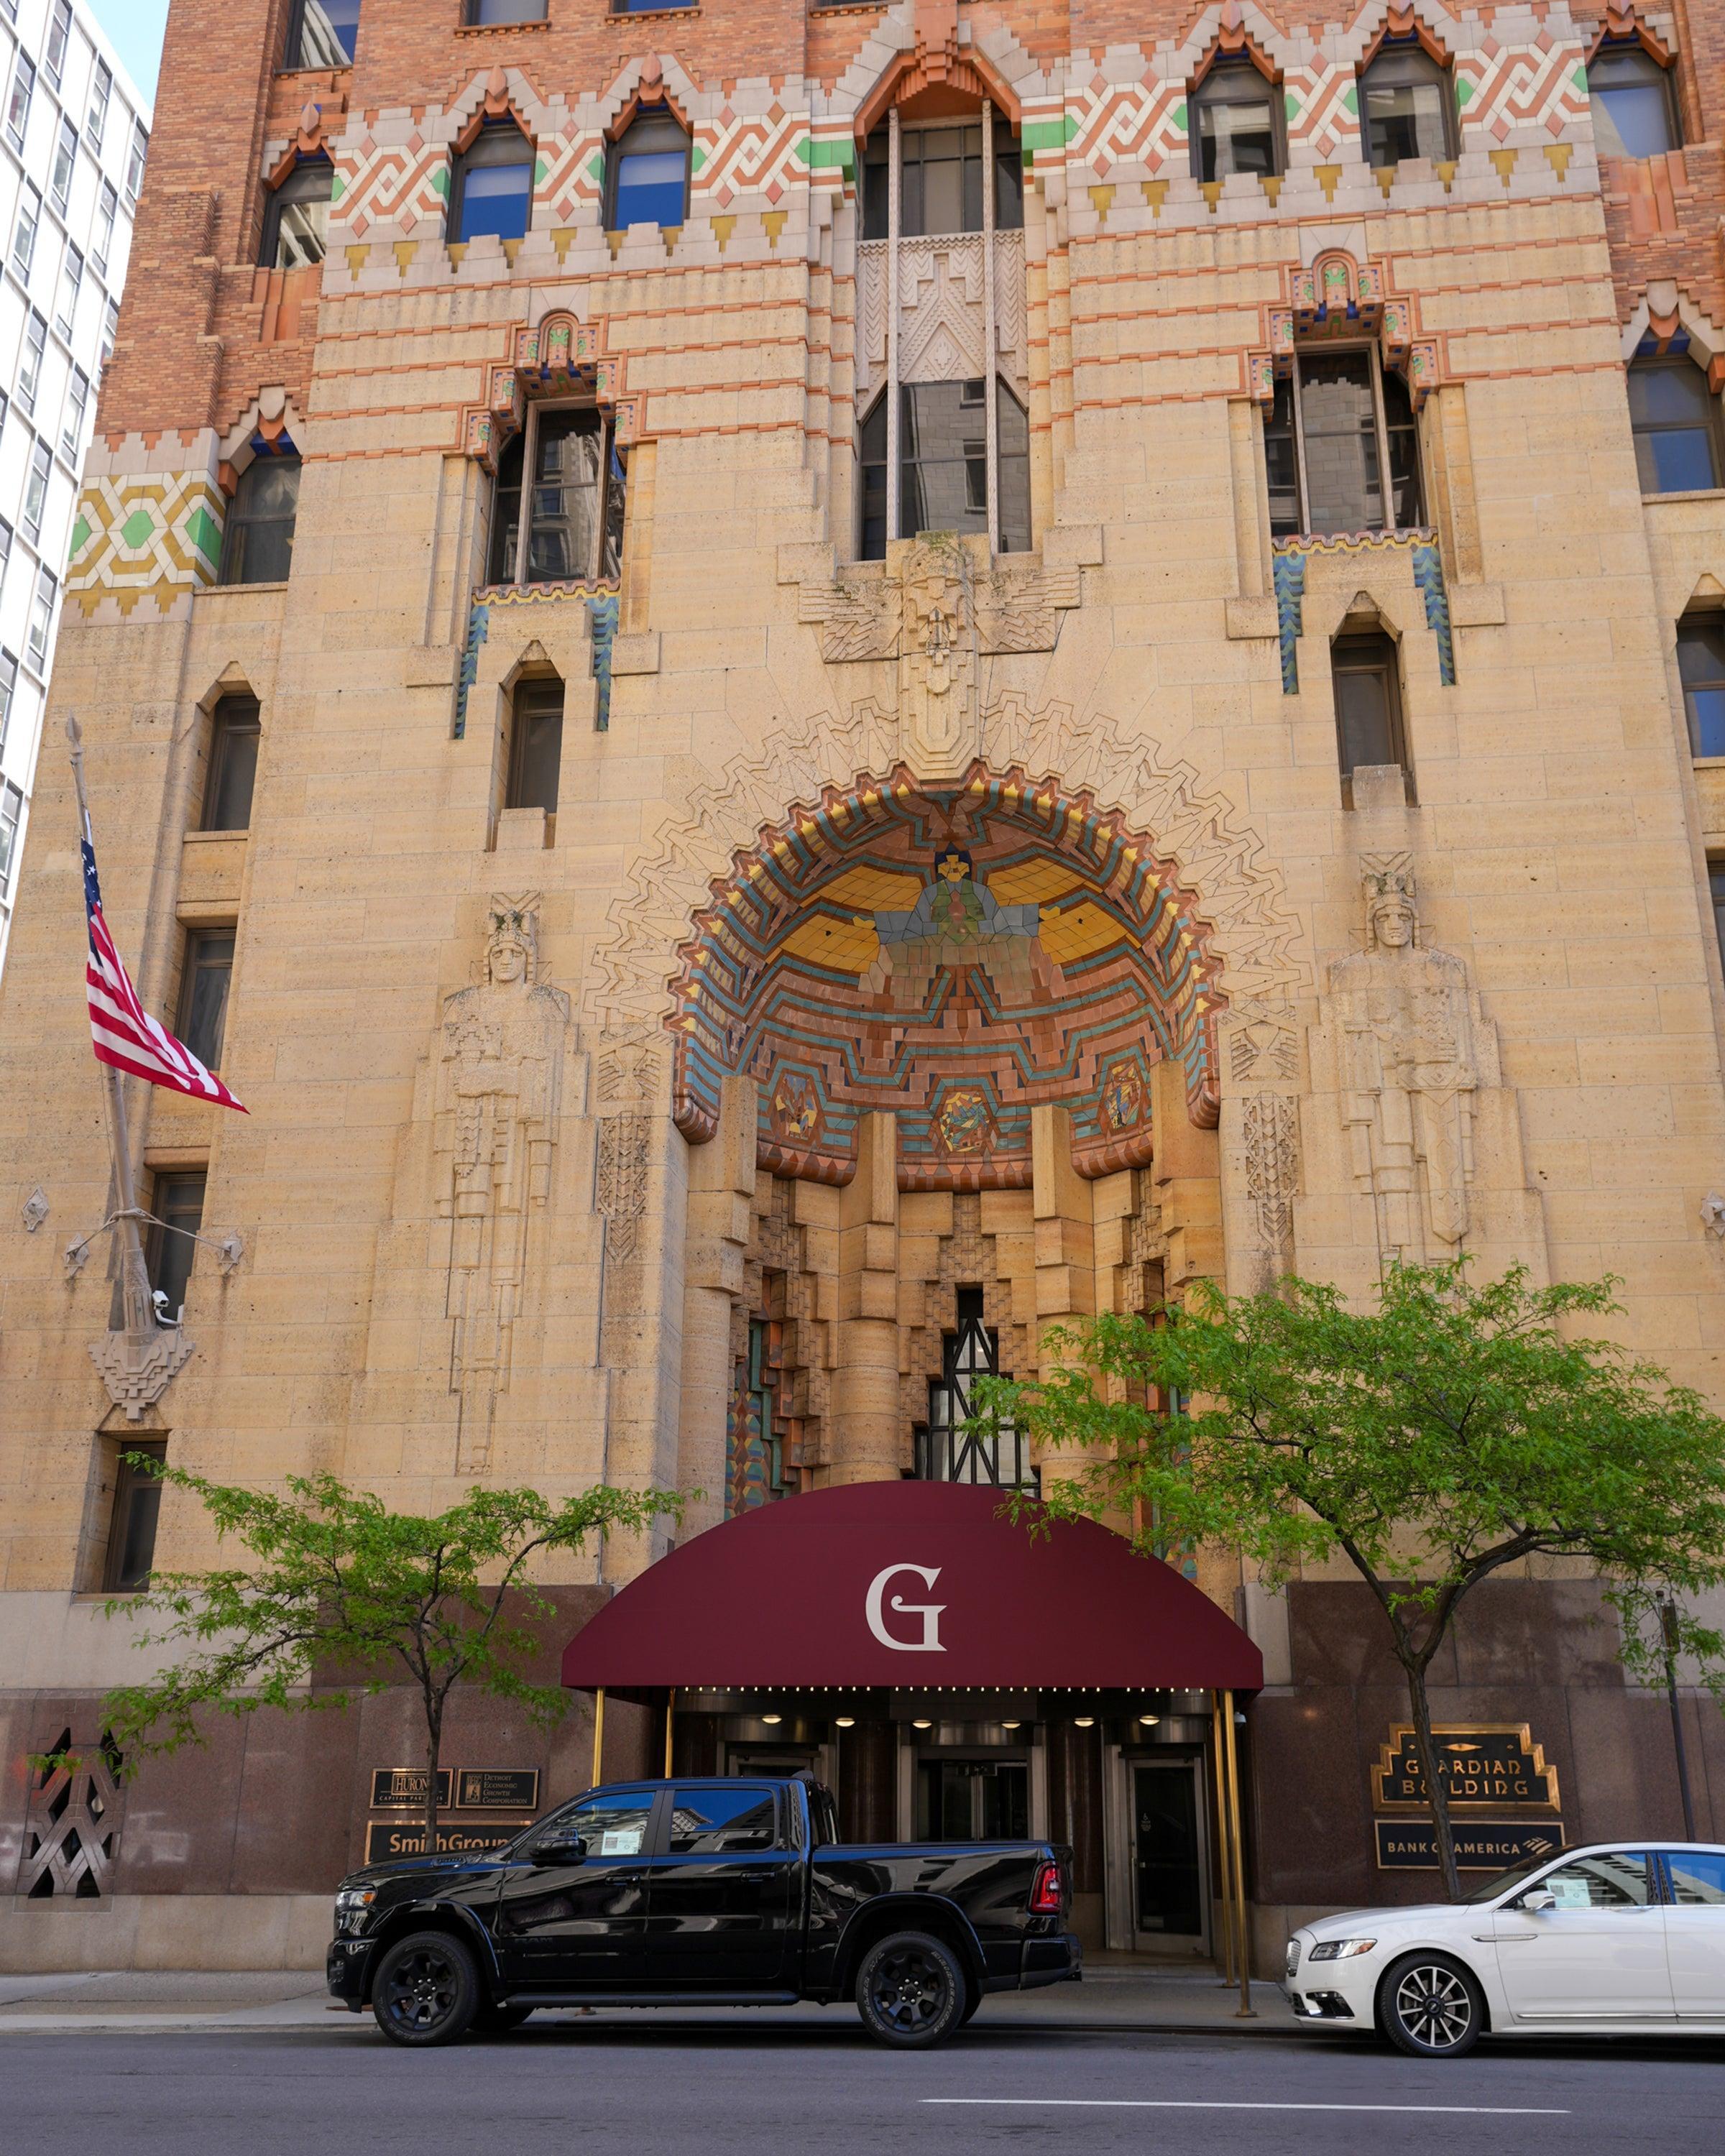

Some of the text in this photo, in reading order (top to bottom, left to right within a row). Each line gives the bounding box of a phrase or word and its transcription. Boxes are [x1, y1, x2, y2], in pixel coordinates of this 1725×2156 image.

[865, 1562, 947, 1651] G
[1405, 1760, 1521, 1774] GARDIAN
[1402, 1780, 1528, 1795] BLDING
[390, 1833, 509, 1853] SmihGrou
[1388, 1842, 1427, 1853] BANK
[1454, 1843, 1521, 1854] AMERICA
